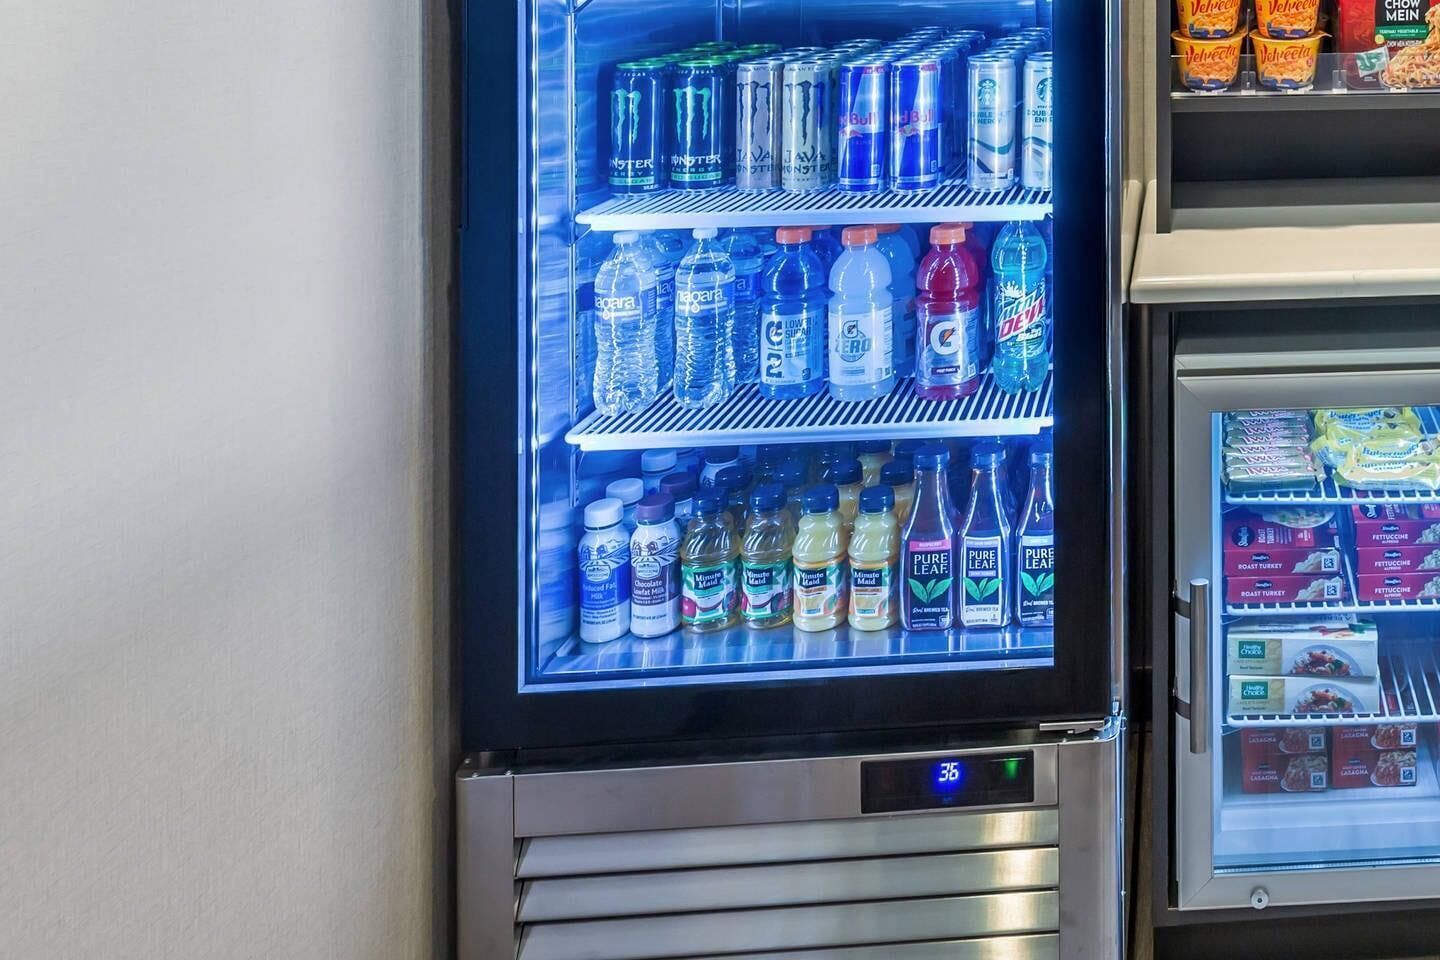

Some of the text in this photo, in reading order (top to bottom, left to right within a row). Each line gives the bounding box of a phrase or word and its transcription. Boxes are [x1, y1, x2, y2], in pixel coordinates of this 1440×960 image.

[1386, 9, 1419, 21] MEIN
[914, 553, 948, 564] PURE
[969, 550, 995, 560] PURE
[1026, 548, 1053, 558] PURE
[938, 762, 959, 782] 36
